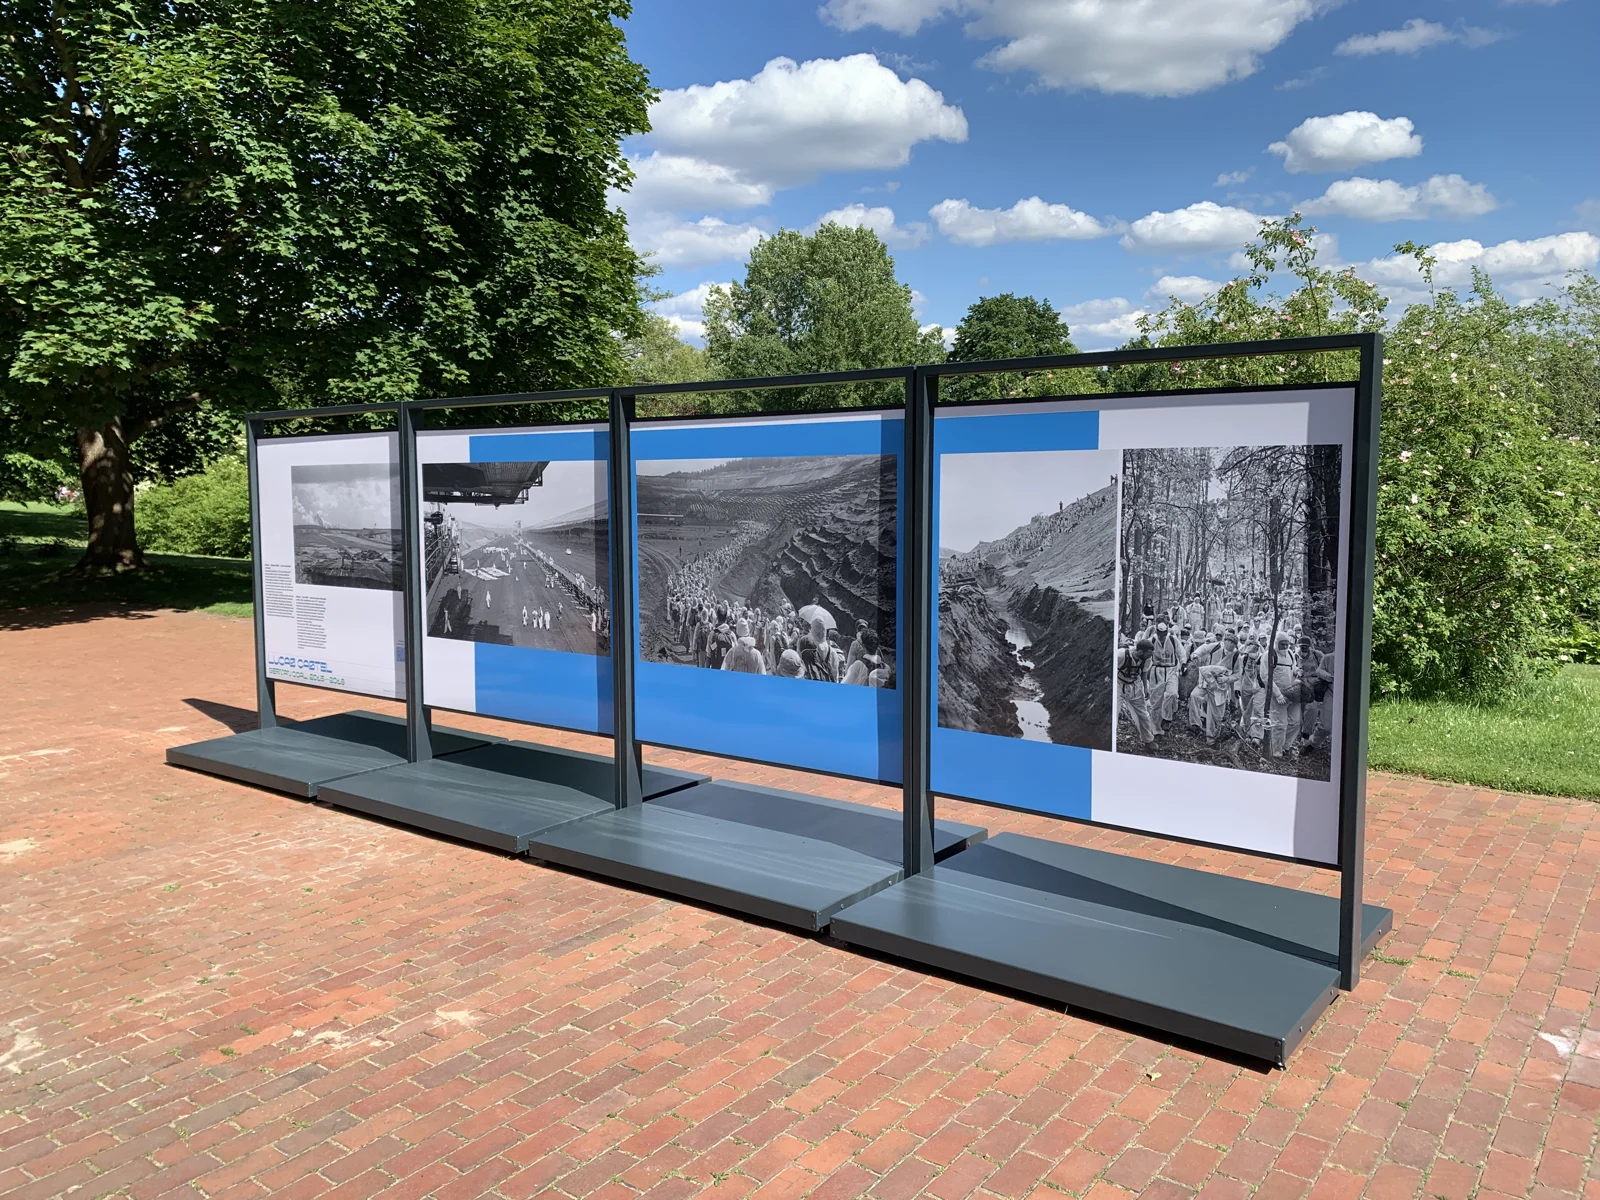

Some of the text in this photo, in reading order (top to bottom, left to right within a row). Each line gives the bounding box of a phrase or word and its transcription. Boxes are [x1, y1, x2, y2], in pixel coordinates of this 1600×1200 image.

[268, 654, 333, 673] LUCAS CASTEL
[292, 670, 308, 680] COAL
